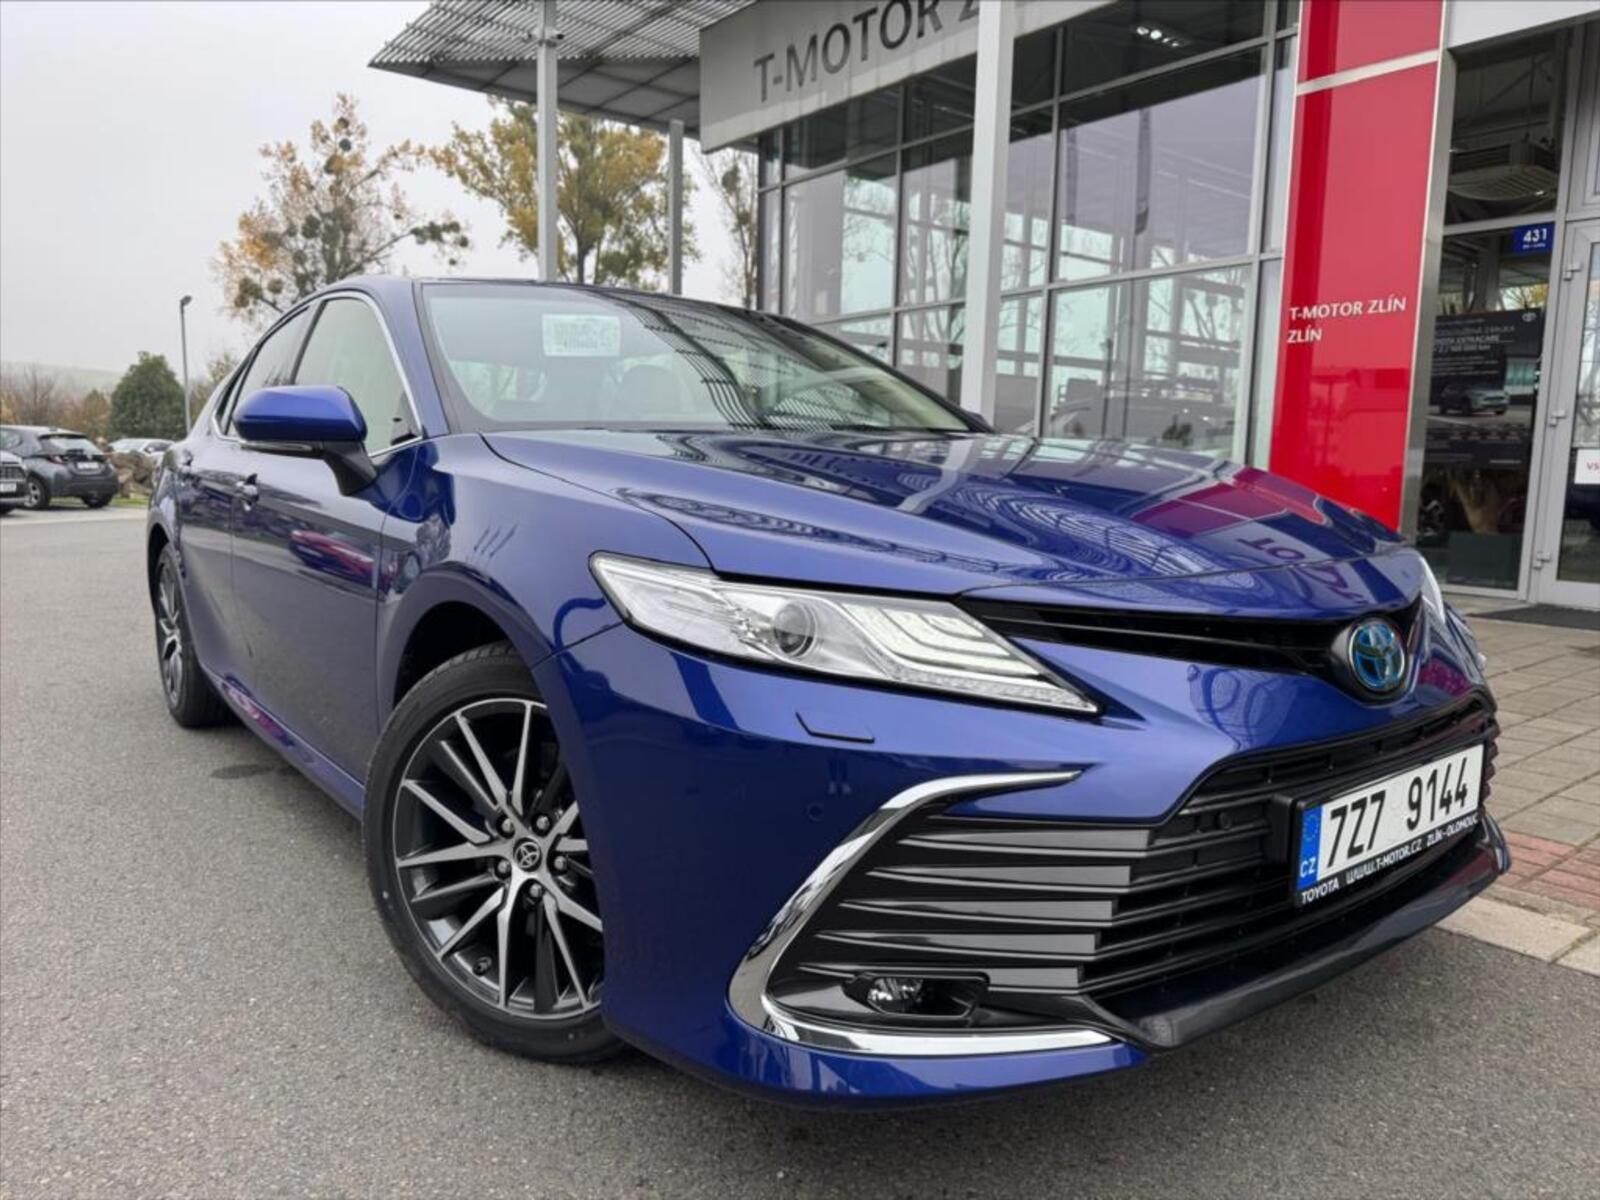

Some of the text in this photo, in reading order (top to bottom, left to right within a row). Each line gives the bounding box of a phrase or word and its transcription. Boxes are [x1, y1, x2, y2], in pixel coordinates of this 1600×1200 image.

[753, 0, 943, 102] T-MOTOR
[1523, 228, 1547, 242] 431
[1290, 293, 1407, 320] T-MOTOR ZLÍN
[1287, 324, 1322, 343] ZLÍN
[1326, 757, 1467, 868] 7Z7 9144
[1299, 857, 1316, 878] CZ
[1301, 877, 1340, 905] TOYOTA
